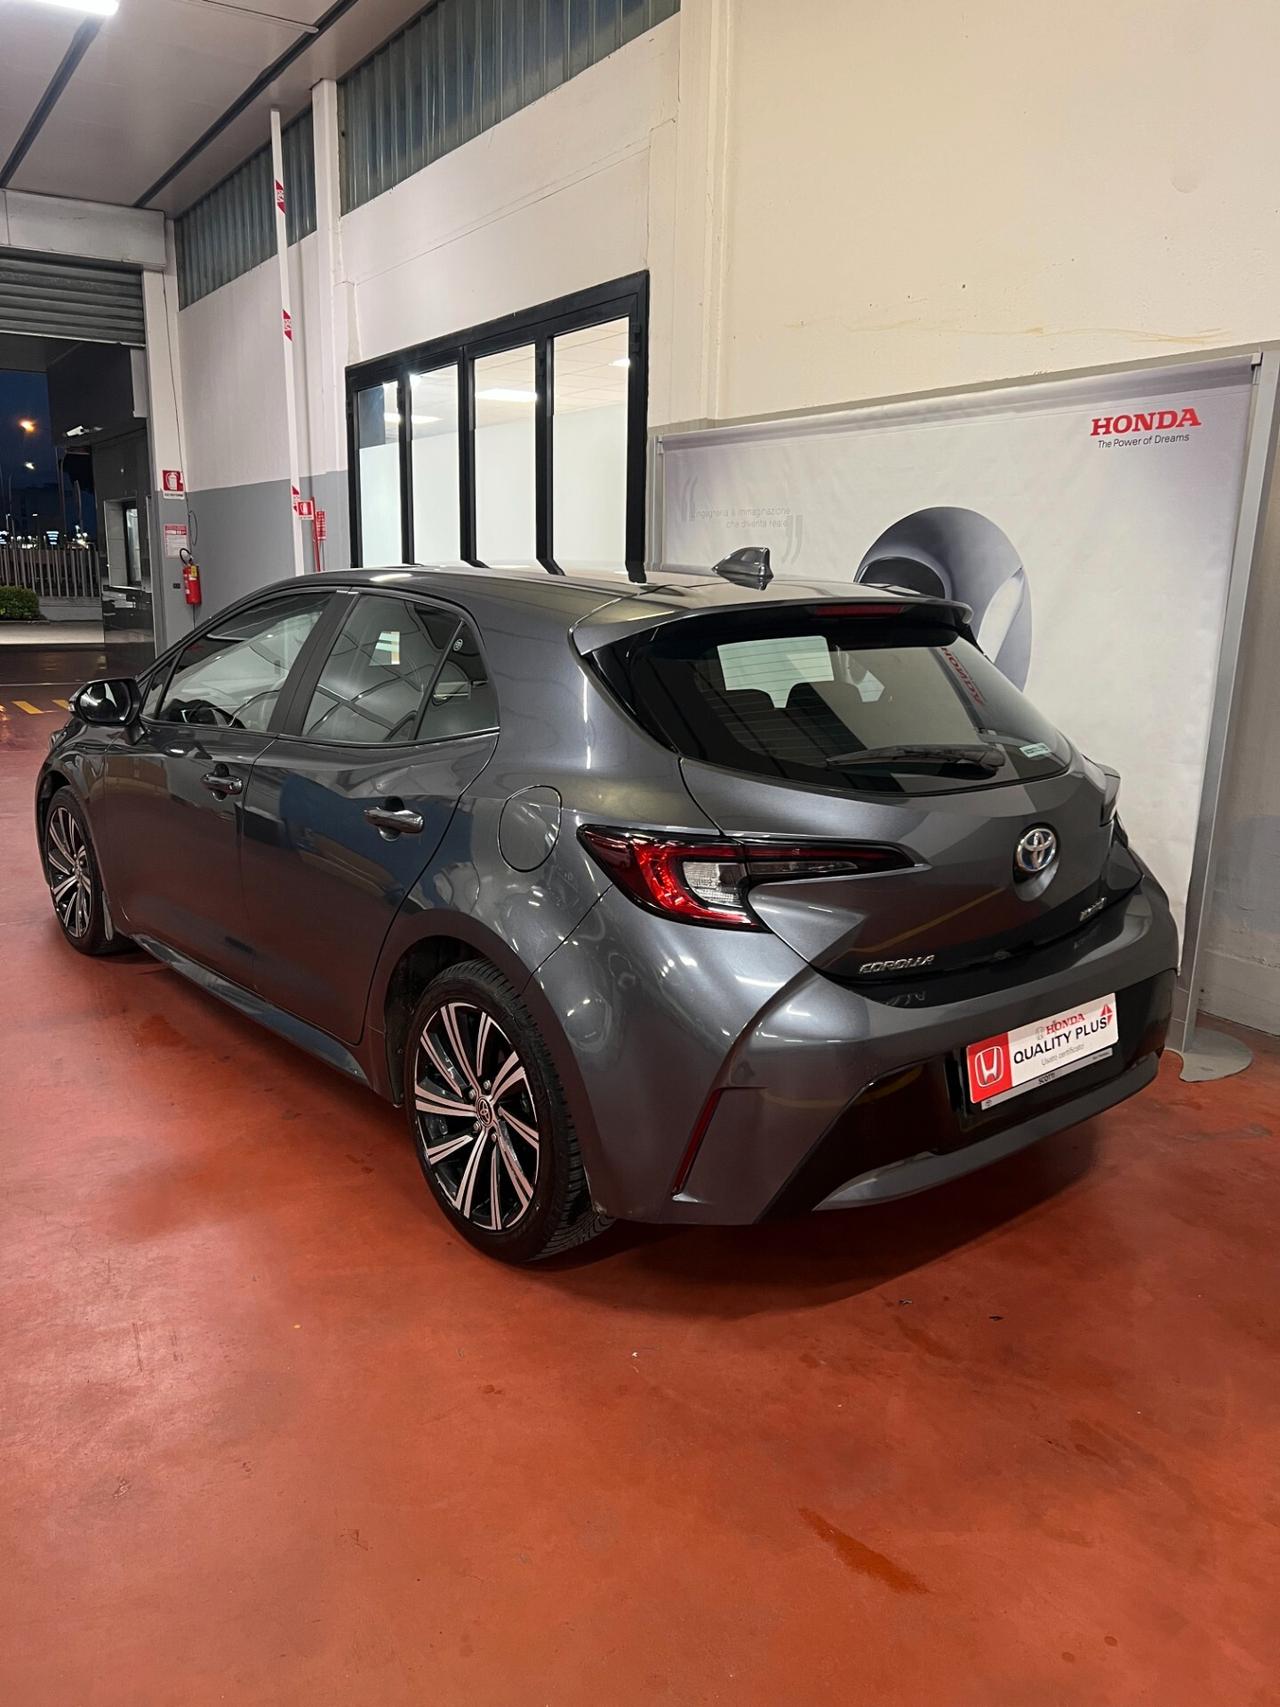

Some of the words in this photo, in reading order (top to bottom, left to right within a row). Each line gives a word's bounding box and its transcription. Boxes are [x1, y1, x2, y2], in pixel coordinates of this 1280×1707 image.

[1090, 407, 1202, 436] HONDA
[1098, 439, 1112, 449] The
[1113, 438, 1141, 448] Power
[1143, 435, 1153, 446] of
[1154, 434, 1190, 444] Dreams
[859, 954, 935, 974] COROLLA
[1046, 1013, 1085, 1035] HONDA
[1013, 1030, 1072, 1065] QUALITY
[1075, 1016, 1107, 1040] PLUS
